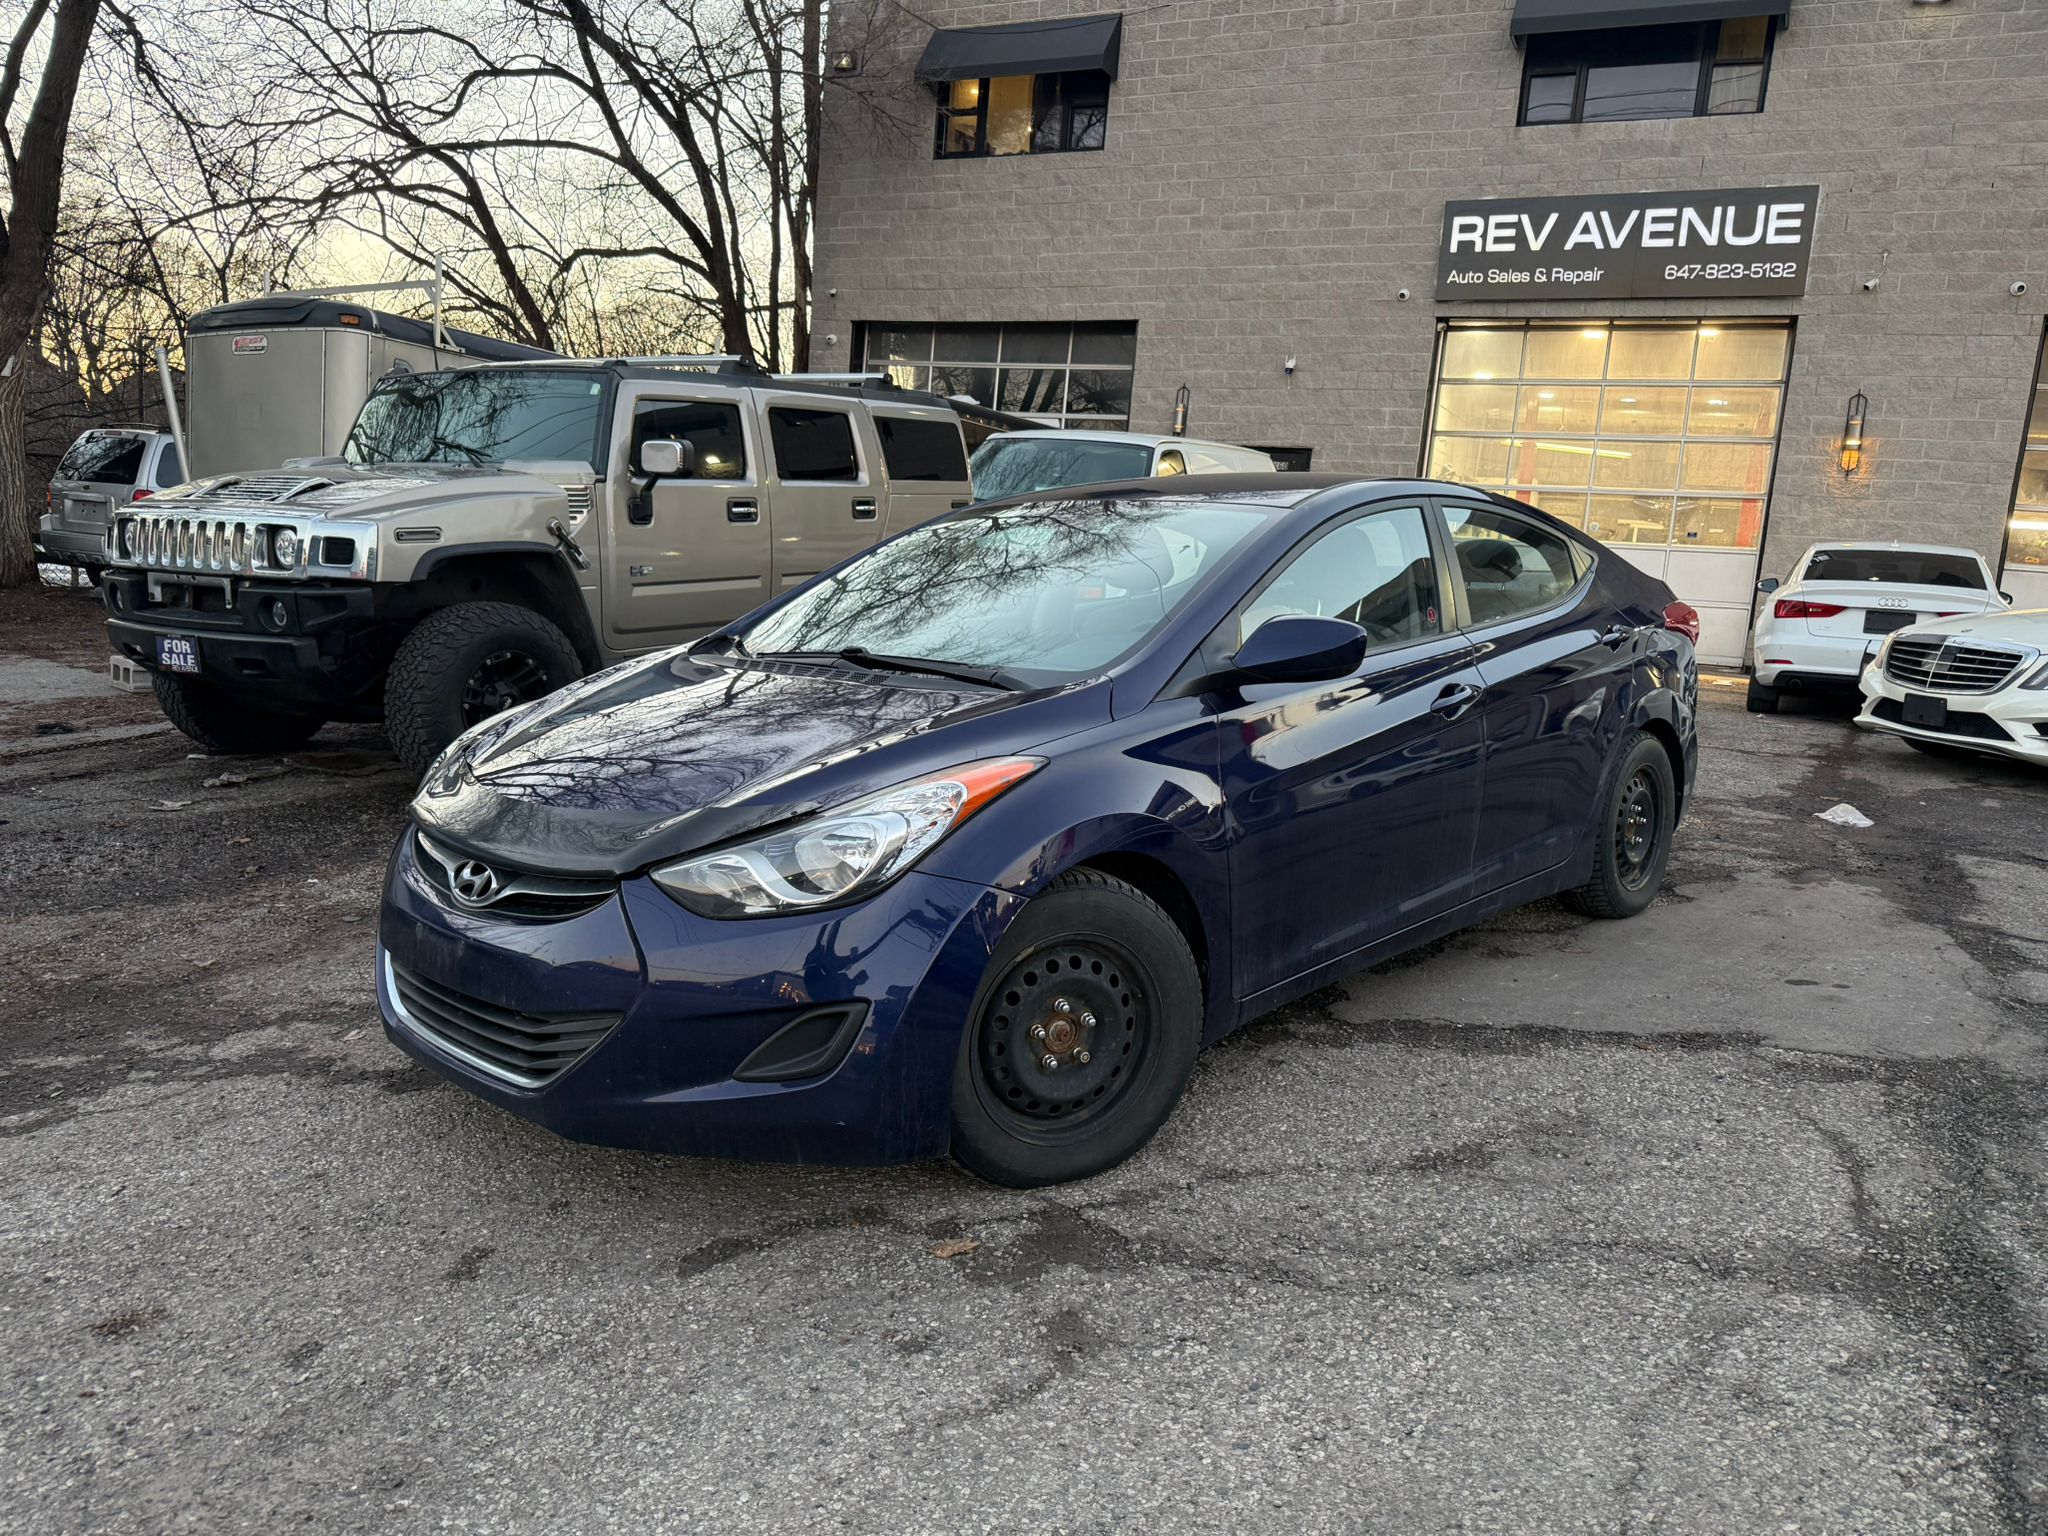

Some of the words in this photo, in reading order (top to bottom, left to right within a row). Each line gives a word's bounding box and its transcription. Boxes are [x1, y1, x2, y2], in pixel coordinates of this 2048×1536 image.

[1449, 212, 1559, 254] REV
[1563, 202, 1805, 251] AVENUE
[1446, 269, 1484, 284] Auto
[1487, 268, 1531, 284] Sales
[1534, 267, 1548, 283] &
[1551, 266, 1605, 285] Repair
[1664, 262, 1797, 280] 647-823-5132
[163, 639, 192, 654] FOR
[161, 652, 196, 667] SALE
